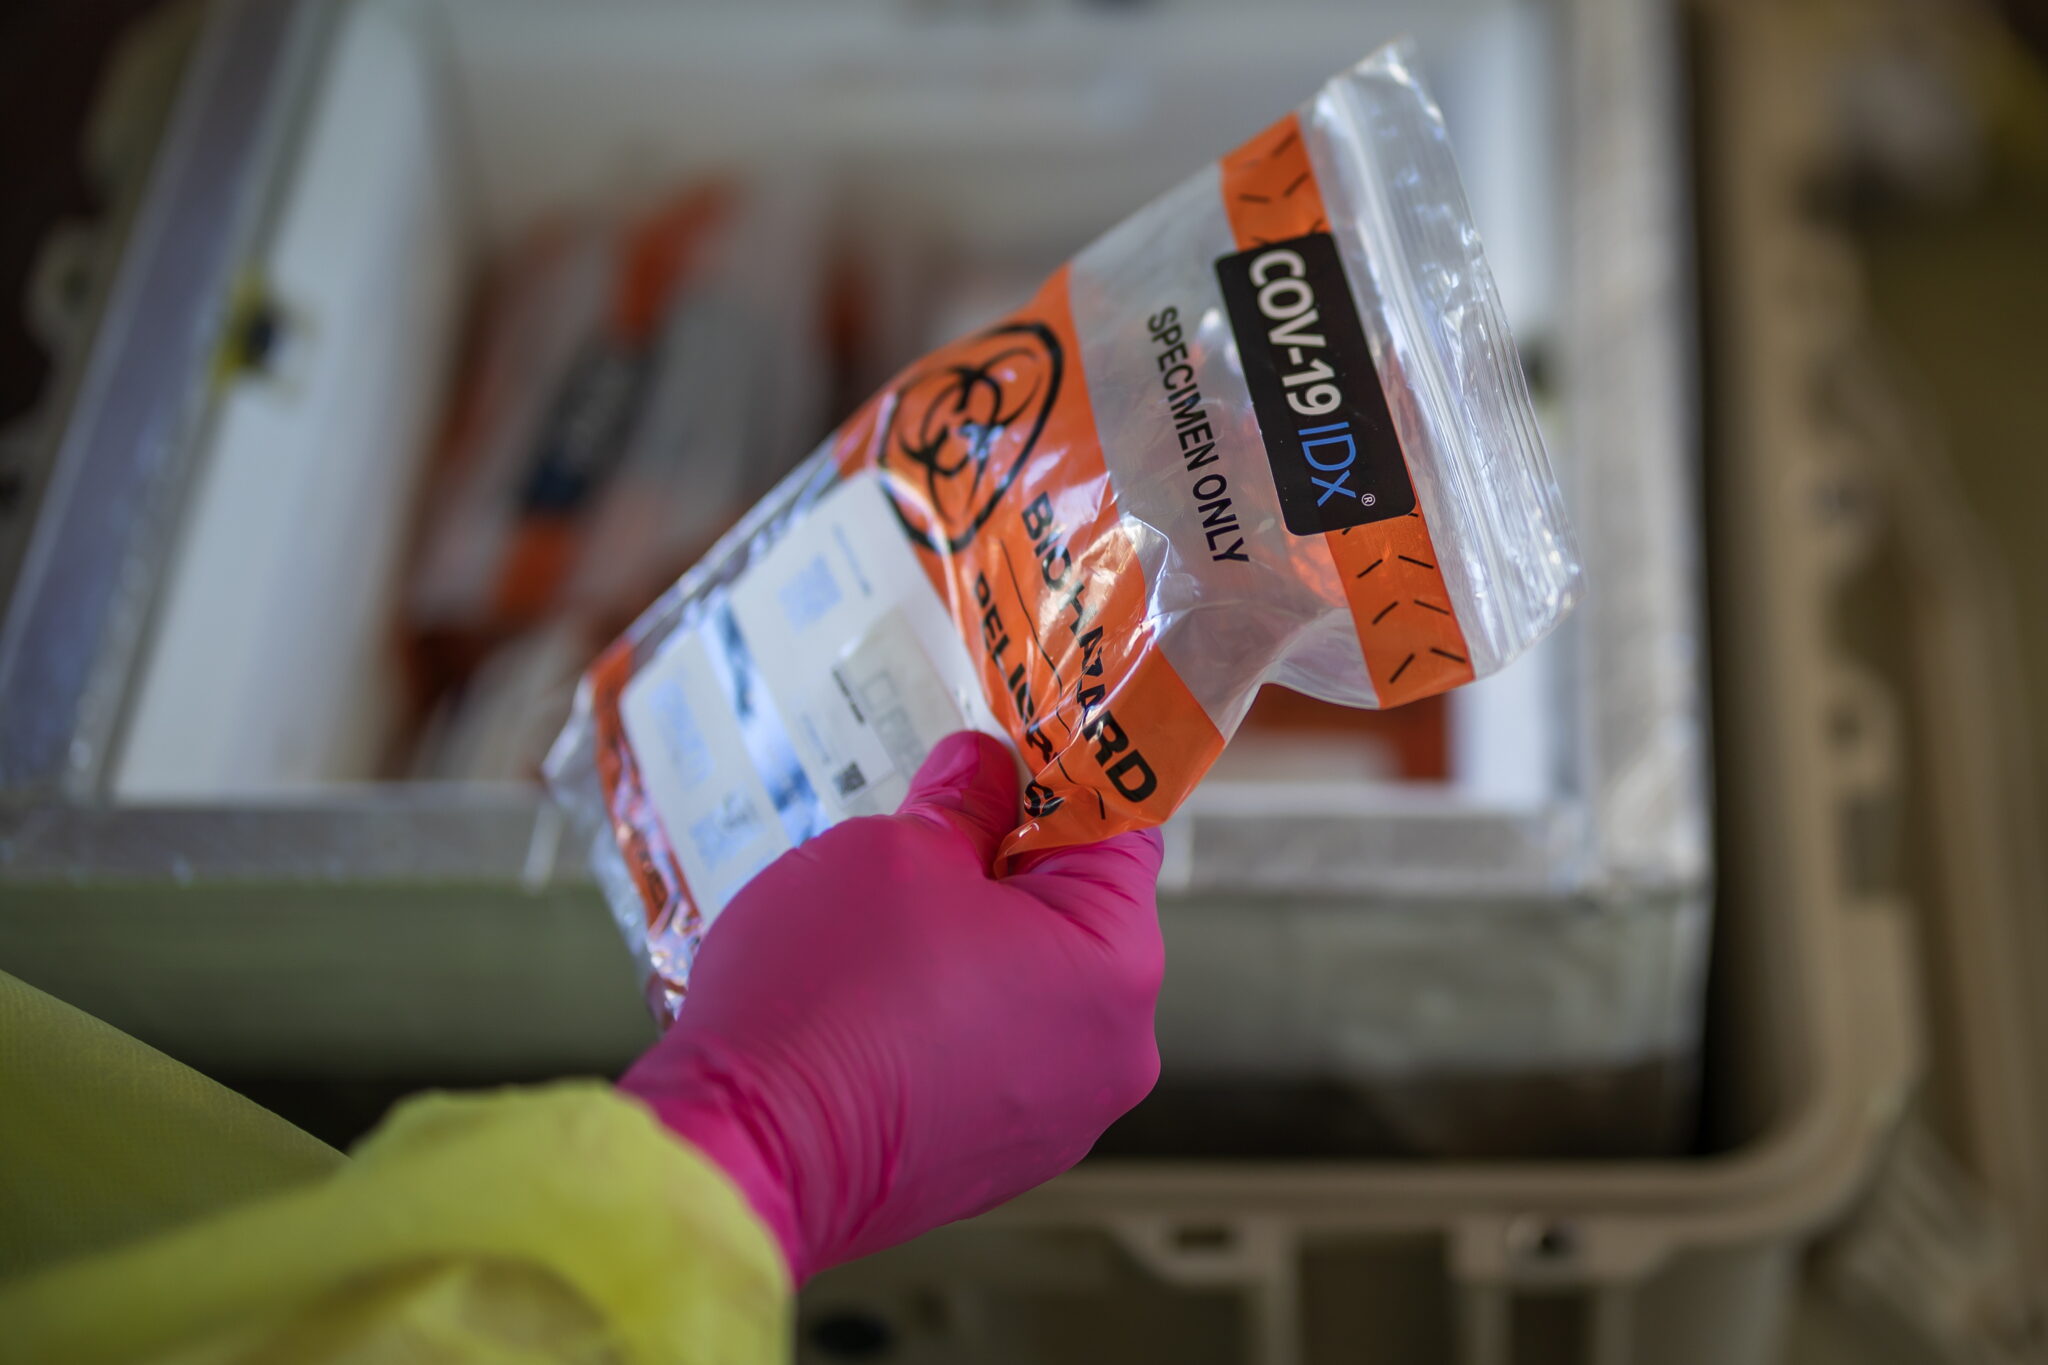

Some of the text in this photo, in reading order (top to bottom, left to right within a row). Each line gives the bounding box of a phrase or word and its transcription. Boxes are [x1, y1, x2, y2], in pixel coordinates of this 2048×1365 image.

[1148, 306, 1250, 563] SPECIMEN ONLY
[1249, 250, 1342, 416] COV-19
